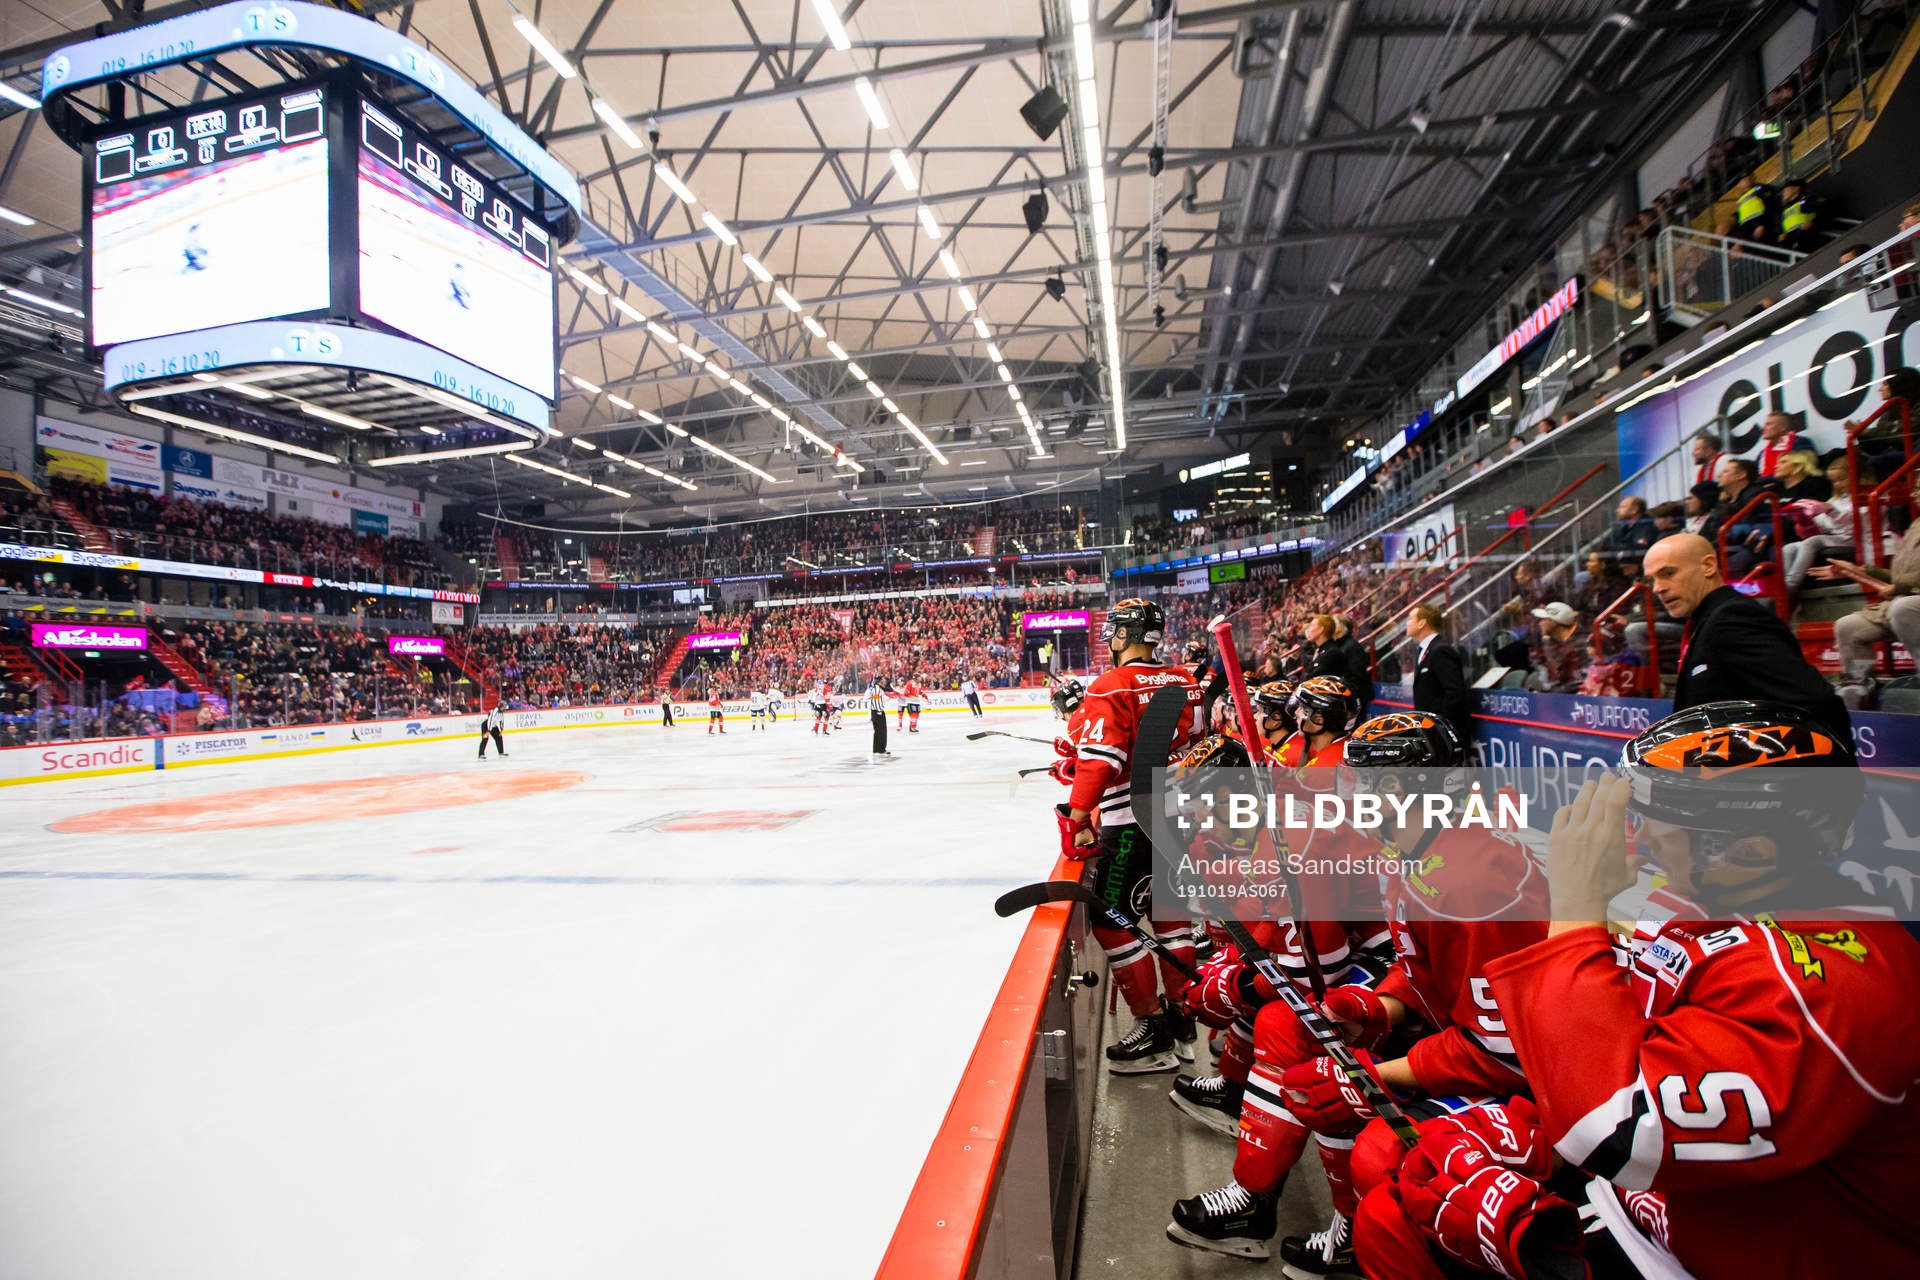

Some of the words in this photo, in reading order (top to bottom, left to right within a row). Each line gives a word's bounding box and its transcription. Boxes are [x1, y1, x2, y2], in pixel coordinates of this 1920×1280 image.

[274, 14, 288, 31] S
[290, 336, 307, 352] T
[319, 337, 332, 354] S
[122, 362, 146, 382] 019
[162, 359, 177, 377] 16
[182, 354, 198, 373] 10
[203, 350, 220, 369] 20
[434, 370, 457, 390] 019
[469, 385, 483, 402] 16
[486, 392, 499, 409] 10
[502, 401, 515, 416] 20
[173, 480, 217, 499] Swegon
[43, 629, 142, 647] Alléskolan
[1489, 694, 1529, 716] BJURFORS
[515, 720, 537, 728] TEAM
[516, 713, 543, 721] TRAVEL
[564, 710, 593, 722] aspen
[1584, 702, 1650, 730] BJURFORS
[1079, 717, 1105, 744] 24
[195, 738, 246, 750] PISCATOR
[42, 744, 143, 771] Scandic
[1659, 1071, 1777, 1161] 51
